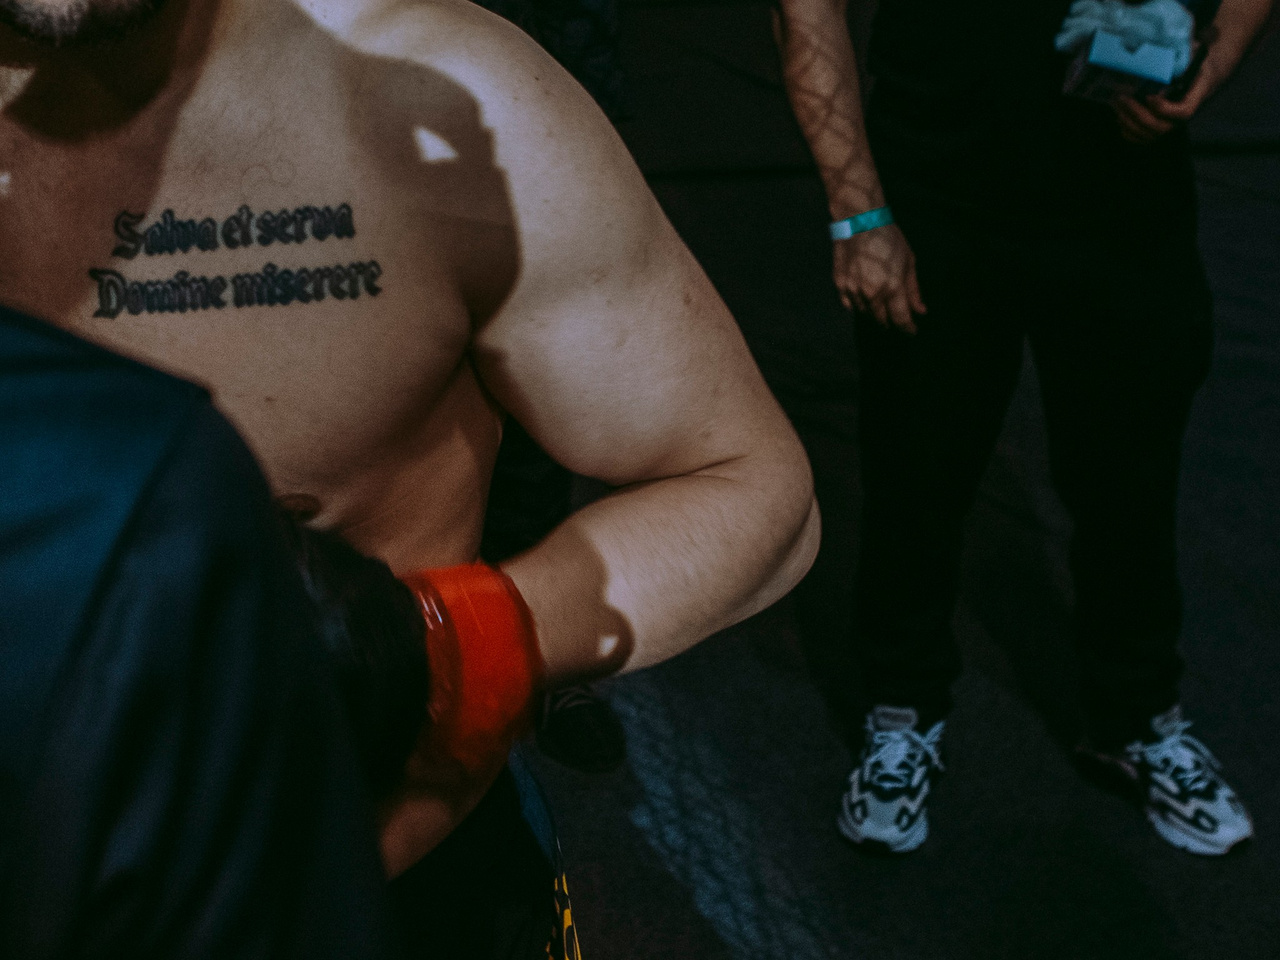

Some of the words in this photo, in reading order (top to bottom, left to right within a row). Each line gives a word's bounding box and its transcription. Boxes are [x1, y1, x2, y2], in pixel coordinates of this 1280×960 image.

[111, 208, 219, 260] Salva
[221, 204, 255, 250] et
[256, 202, 356, 247] serva
[88, 268, 228, 320] Domine
[231, 259, 383, 309] miserere
